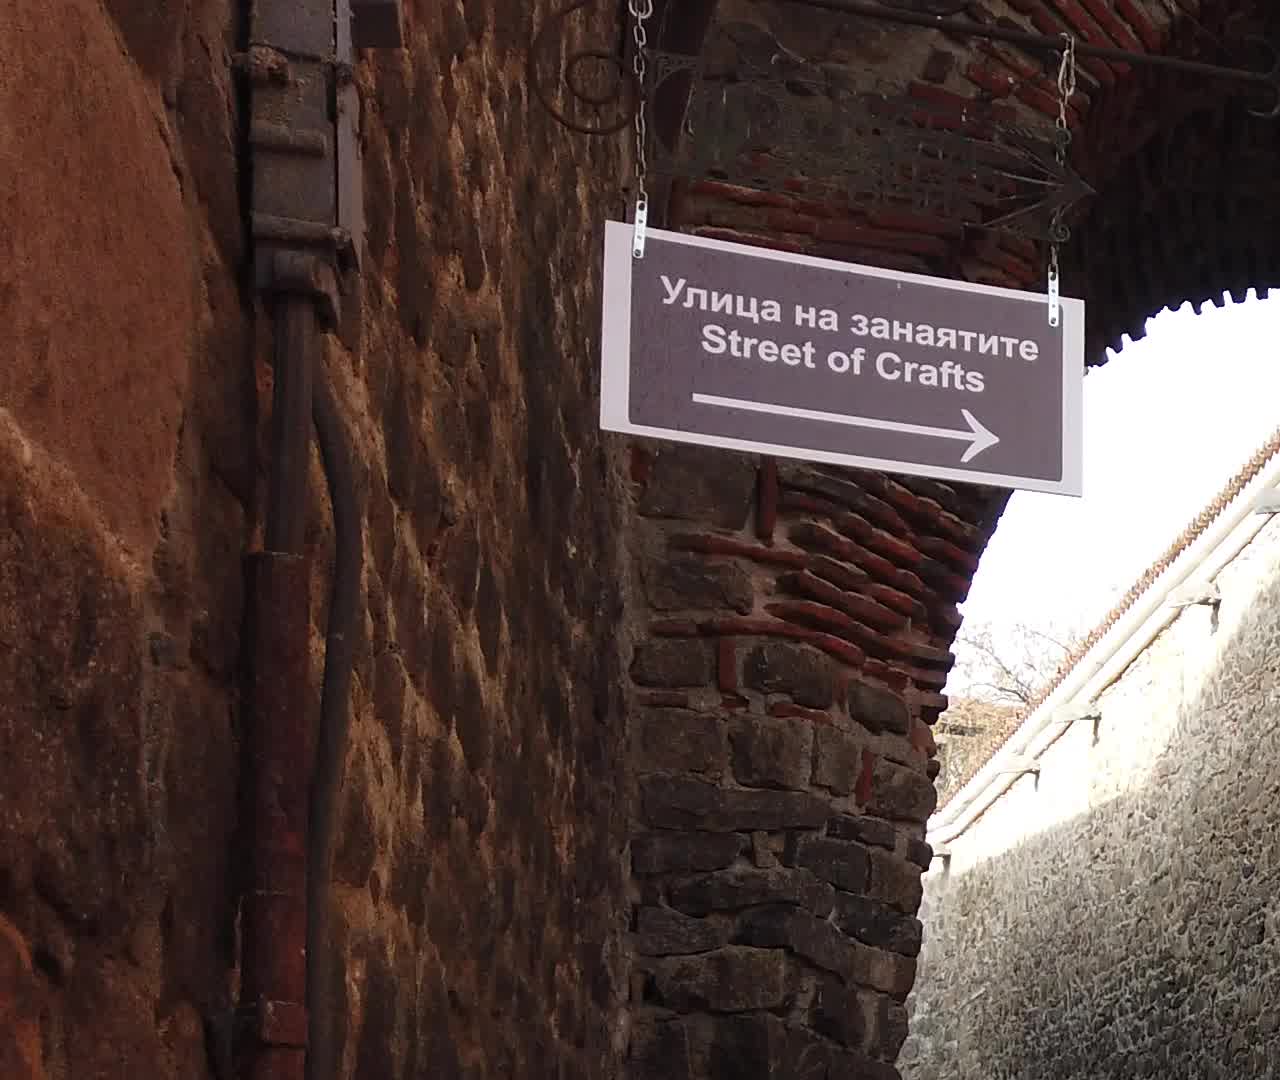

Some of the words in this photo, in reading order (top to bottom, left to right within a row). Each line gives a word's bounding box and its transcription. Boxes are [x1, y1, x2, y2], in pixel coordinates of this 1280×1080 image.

[660, 275, 782, 323] Улица
[794, 304, 839, 332] на
[851, 313, 1039, 361] занаятите
[701, 325, 816, 369] Street
[827, 348, 865, 375] of
[876, 352, 986, 393] Crafts
